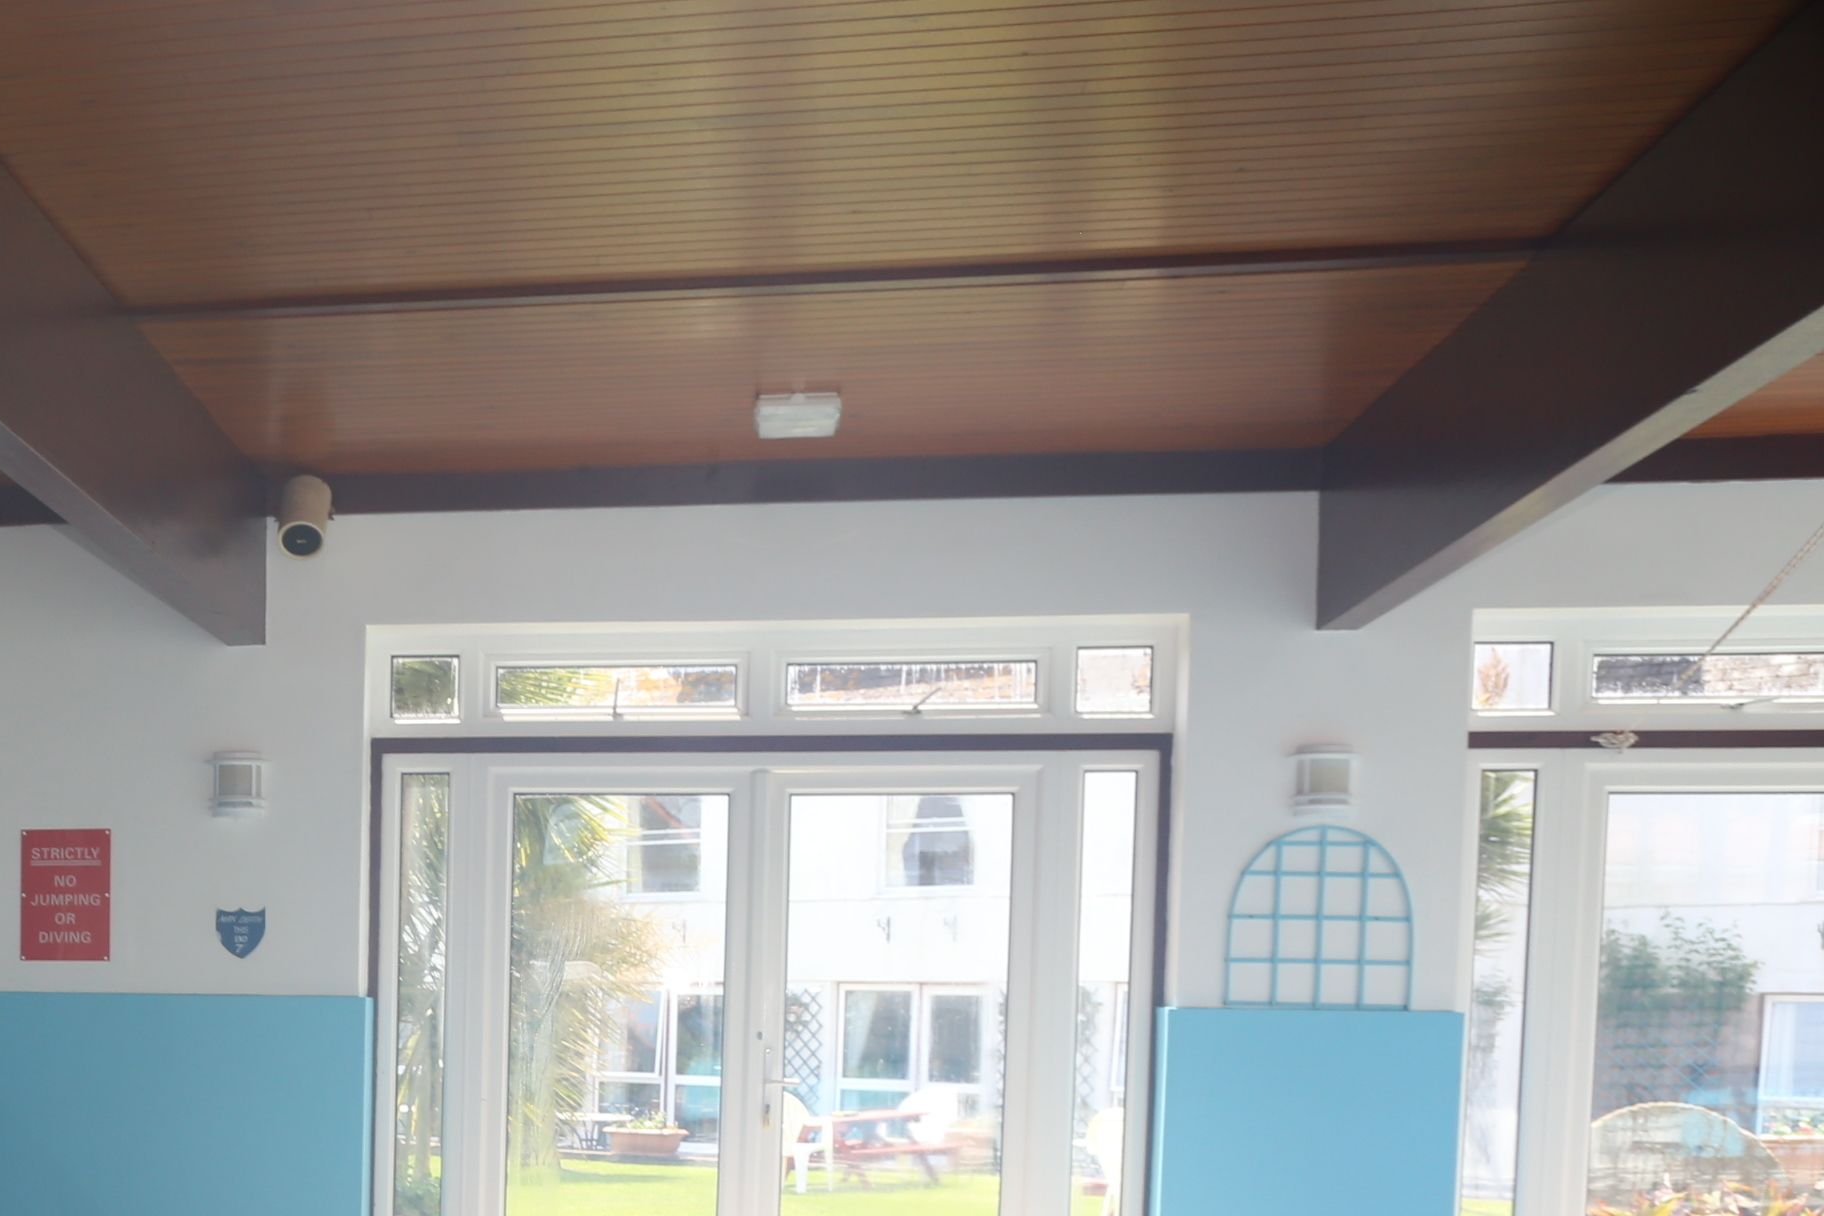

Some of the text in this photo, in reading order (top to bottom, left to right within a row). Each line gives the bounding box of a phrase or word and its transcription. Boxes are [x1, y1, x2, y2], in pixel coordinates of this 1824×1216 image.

[31, 847, 100, 860] STRICTLY
[53, 874, 77, 887] NO
[30, 893, 101, 907] JUMPING
[54, 912, 76, 925] OR
[38, 931, 92, 944] DIVING
